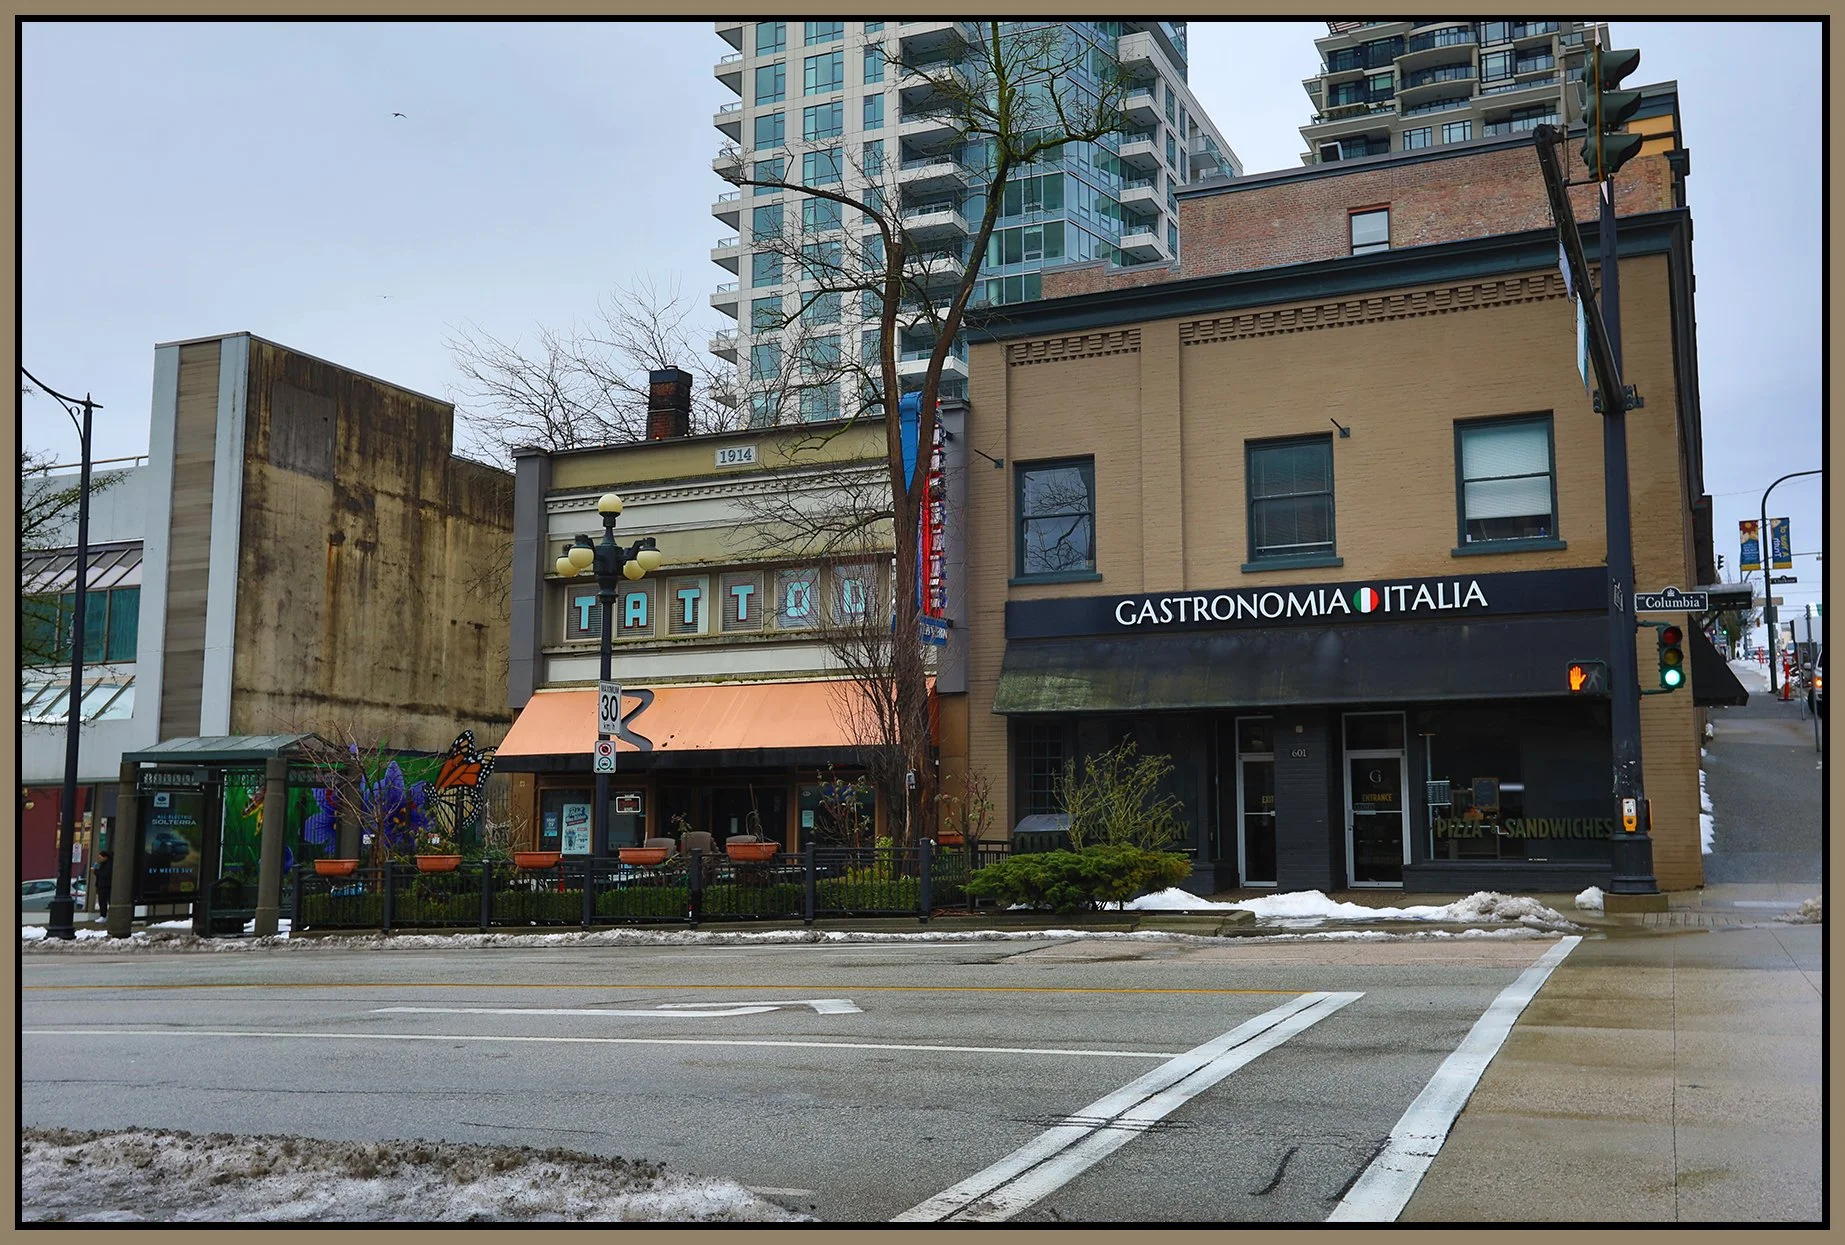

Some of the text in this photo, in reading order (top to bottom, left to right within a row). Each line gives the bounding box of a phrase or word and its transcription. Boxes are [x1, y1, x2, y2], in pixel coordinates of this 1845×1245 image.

[720, 448, 752, 464] 1914
[574, 579, 867, 630] TATTOO
[1115, 580, 1488, 626] GASTRONOMIA ITALIA
[1645, 596, 1700, 609] Columbia
[601, 684, 619, 695] MAXIMUM
[601, 694, 618, 722] 30
[1292, 749, 1307, 758] 601
[1361, 793, 1392, 802] ENTRANCE
[1436, 817, 1482, 838] PIZZA
[1504, 818, 1614, 839] SANDWICHES
